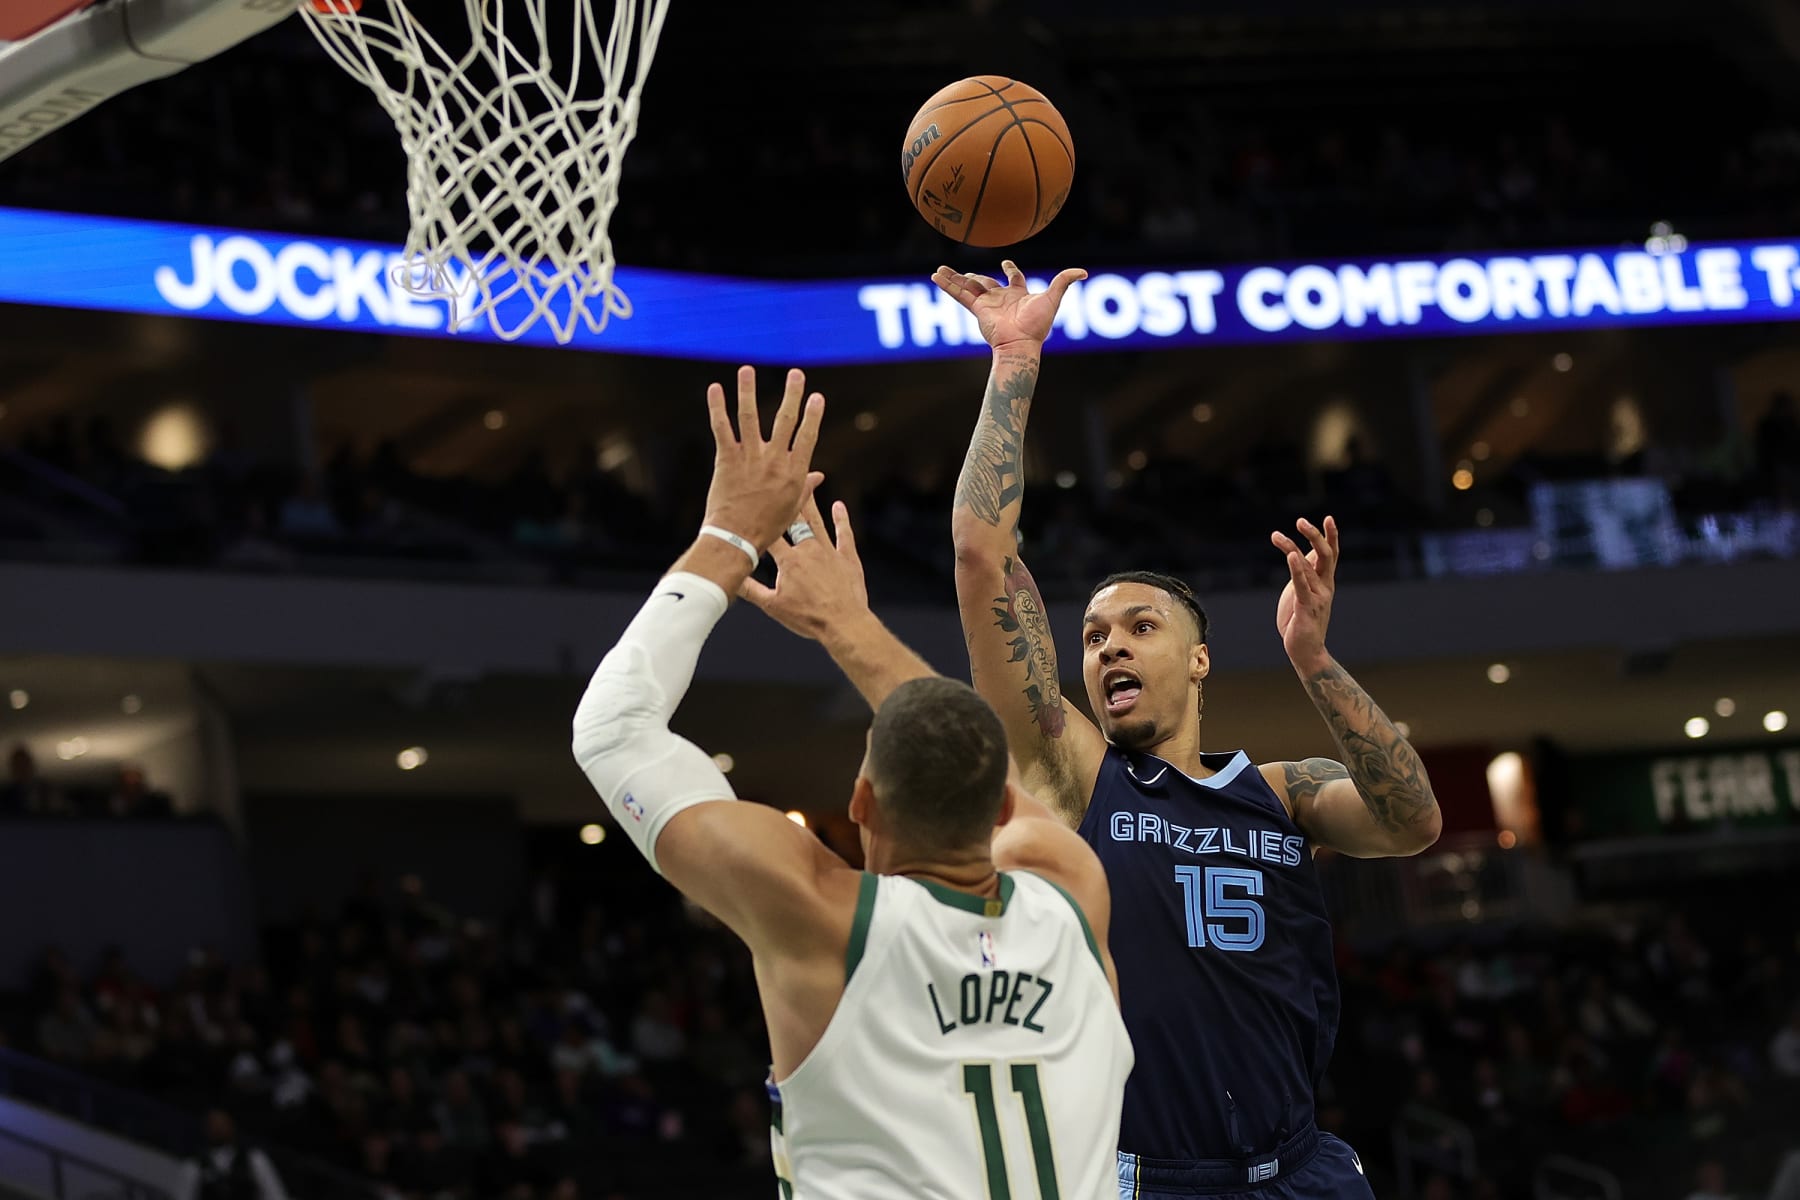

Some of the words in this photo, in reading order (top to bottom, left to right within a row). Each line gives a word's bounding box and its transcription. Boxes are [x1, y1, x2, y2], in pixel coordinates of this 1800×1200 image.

[154, 234, 488, 332] JOCKEY
[858, 282, 992, 349] TH
[1236, 247, 1748, 332] COMFORTABLE
[1750, 245, 1800, 308] T
[1109, 811, 1304, 866] GRIZZLIES
[1174, 864, 1266, 952] 15
[927, 969, 1053, 1036] LOPEZ
[960, 1058, 1061, 1200] 11
